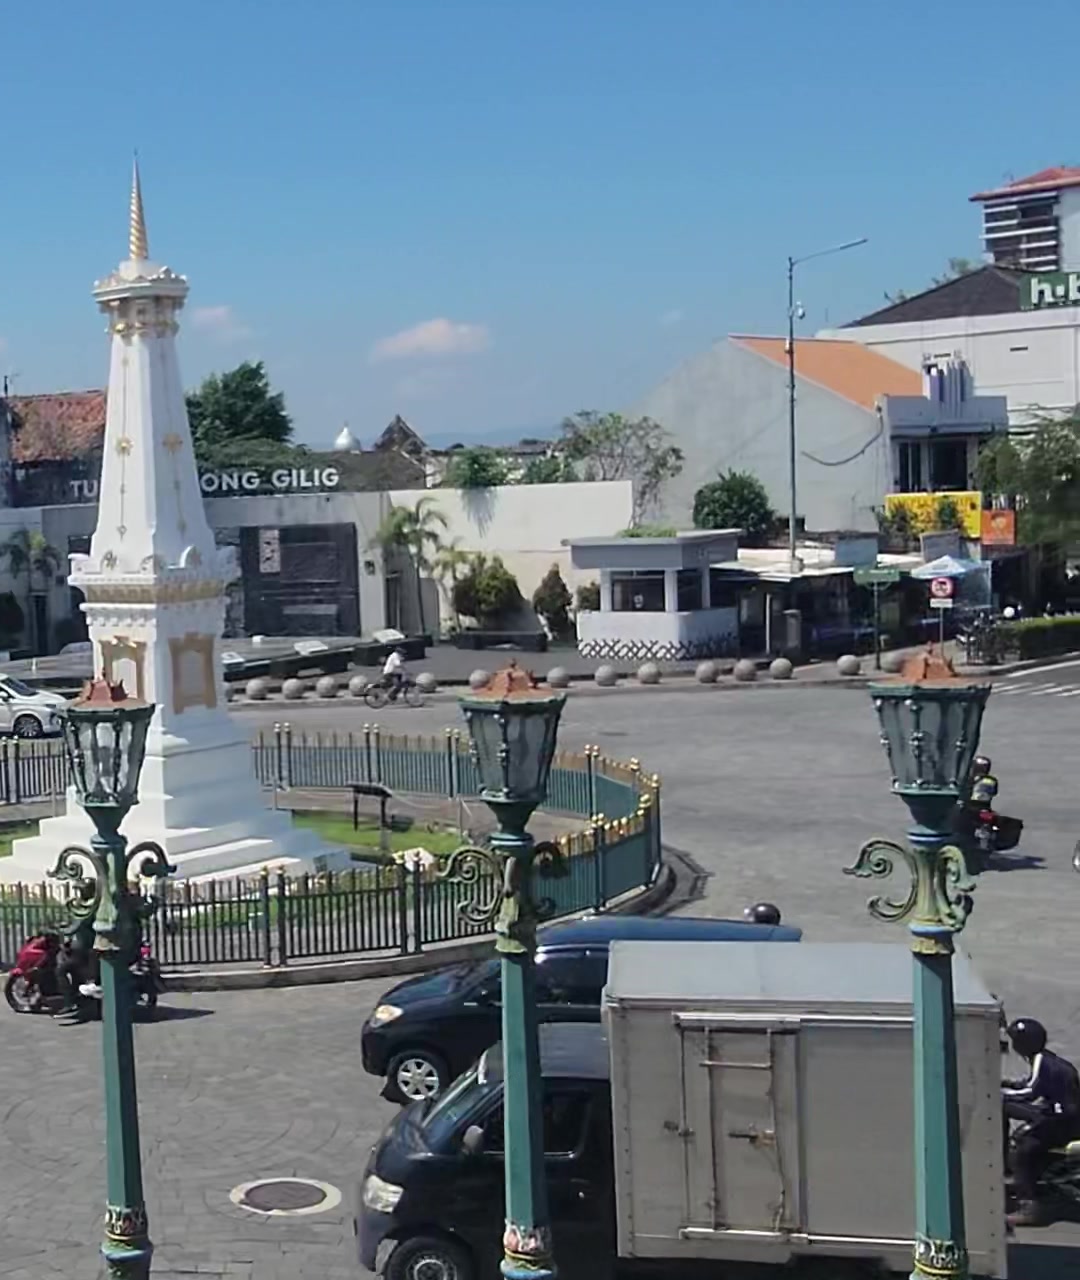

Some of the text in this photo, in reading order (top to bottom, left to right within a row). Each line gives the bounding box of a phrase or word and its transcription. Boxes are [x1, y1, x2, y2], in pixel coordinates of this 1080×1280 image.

[70, 468, 339, 497] TU ONG GILIG
